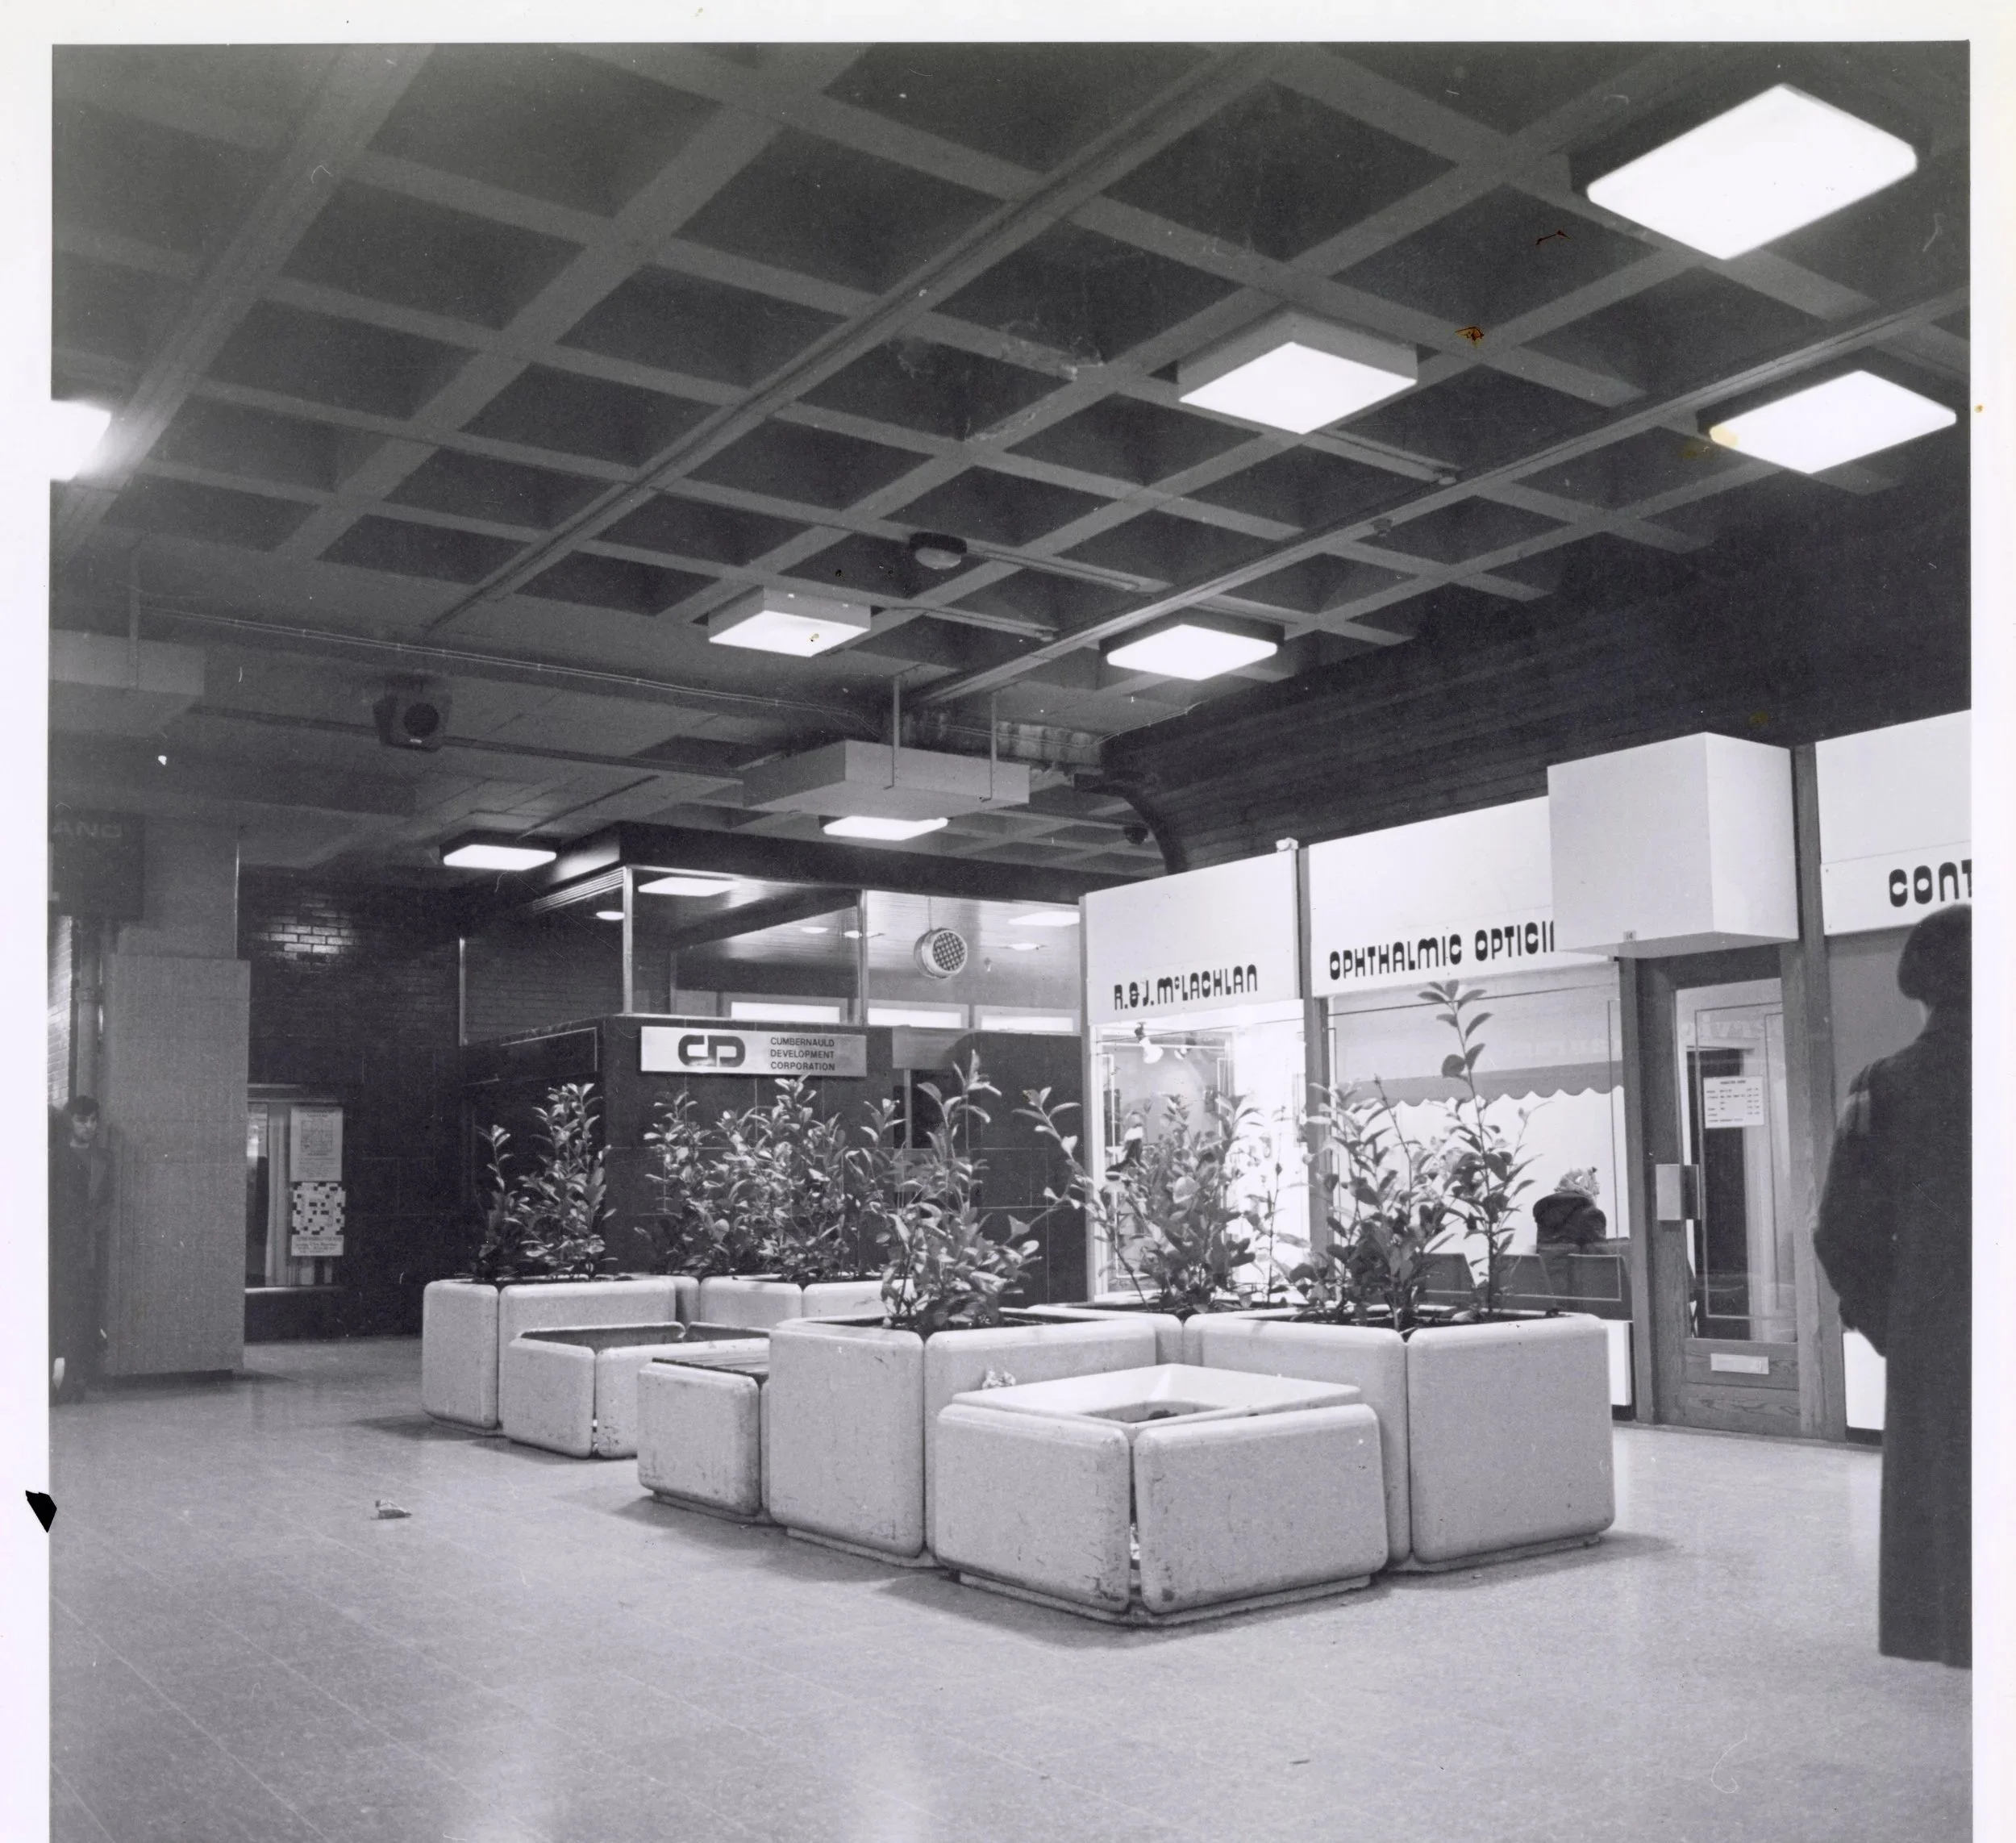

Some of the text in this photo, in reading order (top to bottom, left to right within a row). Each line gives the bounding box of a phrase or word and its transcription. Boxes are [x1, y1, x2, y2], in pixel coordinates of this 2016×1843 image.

[1330, 933, 1463, 981] OPHTHALMIC
[770, 1037, 835, 1048] CUMBERNAULD
[770, 1049, 835, 1060] DEVELOPMENT
[770, 1061, 835, 1071] CORPORATION
